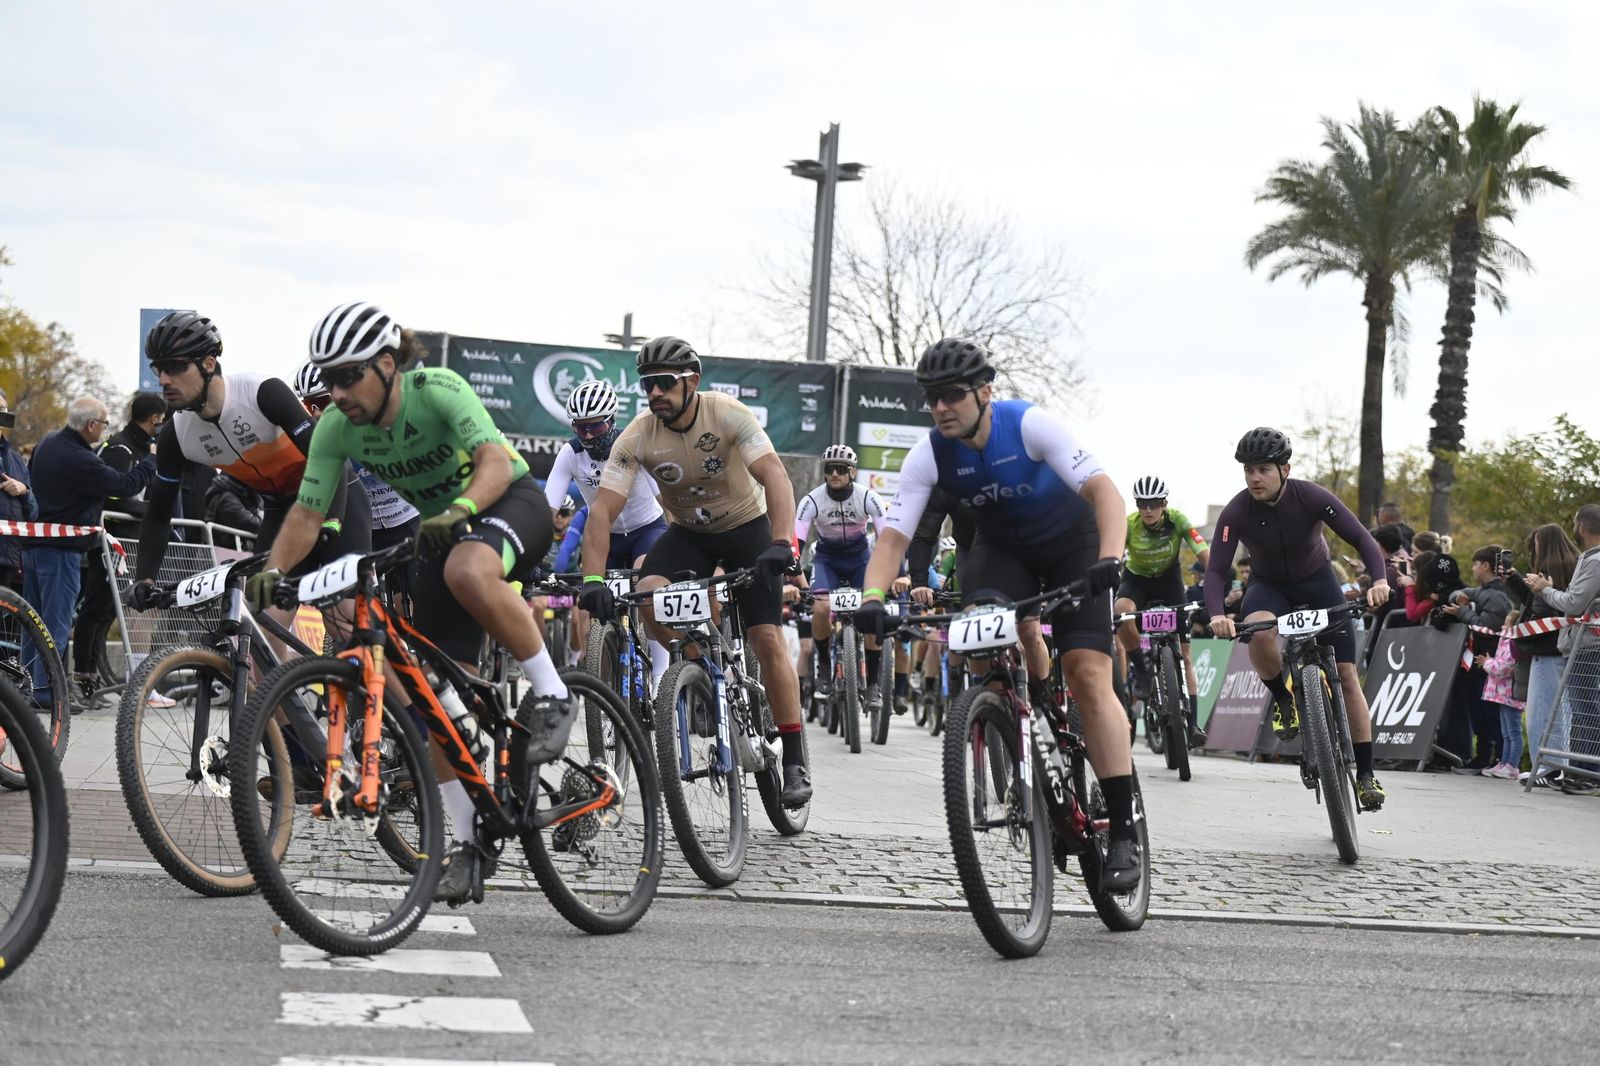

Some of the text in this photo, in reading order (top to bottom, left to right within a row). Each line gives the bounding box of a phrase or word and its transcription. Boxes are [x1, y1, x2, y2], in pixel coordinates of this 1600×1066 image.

[469, 372, 514, 385] GRANADA
[184, 572, 220, 599] 43-1
[663, 592, 702, 618] 57-2
[835, 594, 857, 608] 42-2
[27, 609, 55, 649] MAXXIS
[961, 615, 1006, 644] 71-2
[1145, 613, 1173, 628] 107-1
[1286, 610, 1321, 630] 48-2
[1369, 671, 1437, 726] NDL
[737, 764, 748, 817] MAXXIS
